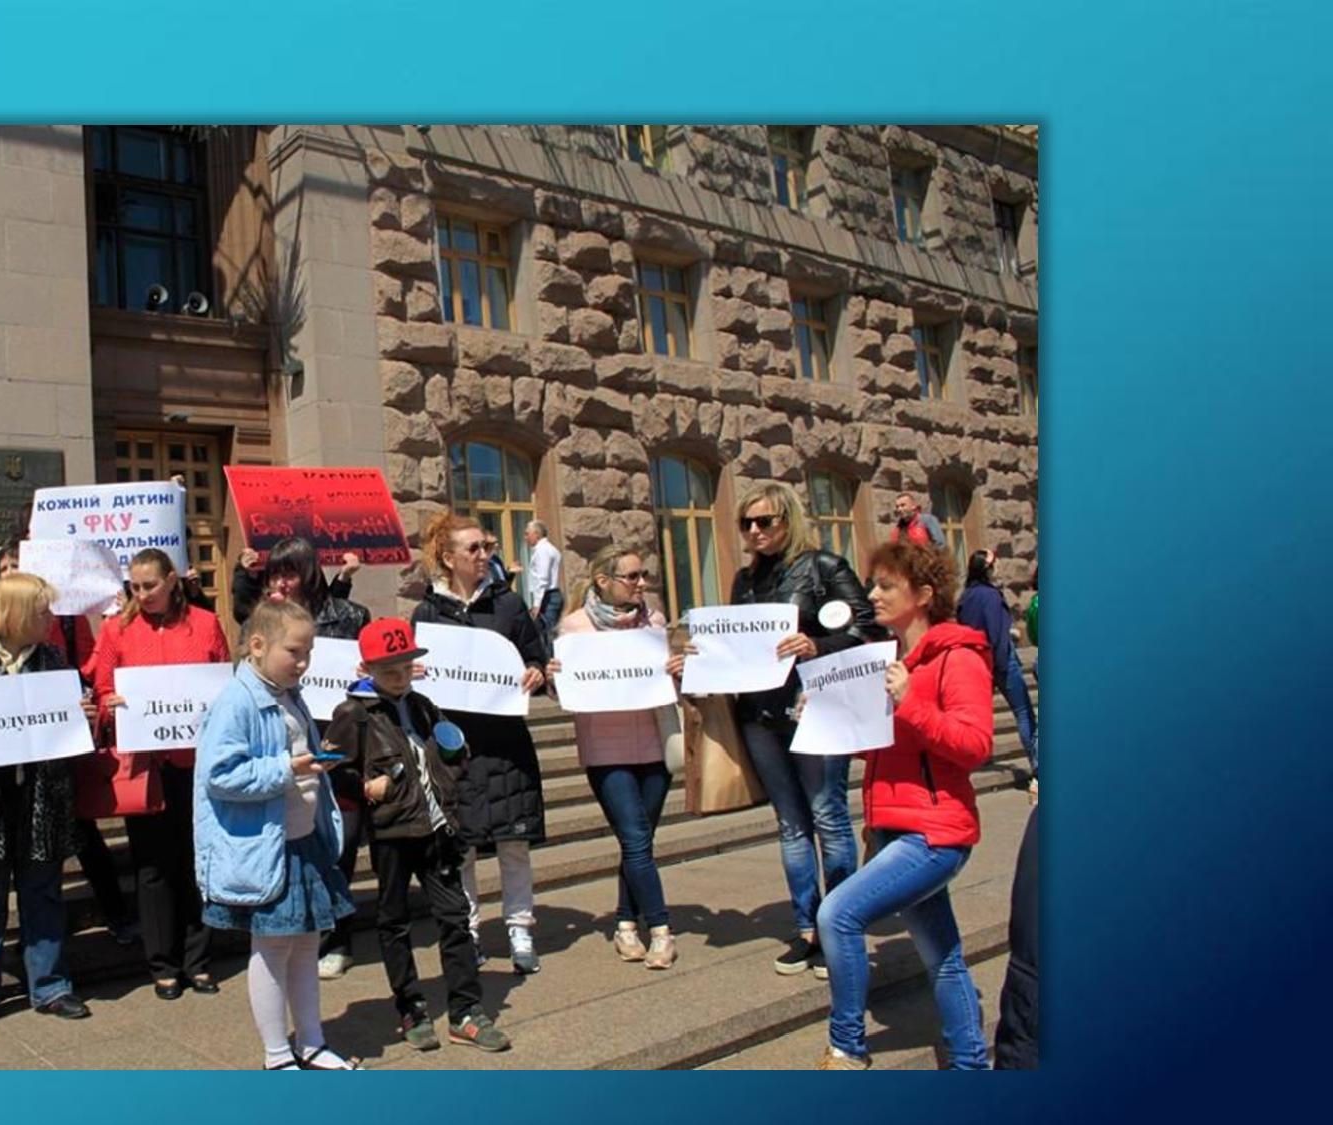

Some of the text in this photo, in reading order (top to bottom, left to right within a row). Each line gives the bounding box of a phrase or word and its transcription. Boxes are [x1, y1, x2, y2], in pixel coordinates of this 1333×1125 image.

[37, 493, 175, 512] КОЖНІЙ ДИТИНІ
[83, 511, 133, 534] ФКУ
[689, 616, 791, 638] російського
[383, 628, 410, 653] 23
[573, 665, 654, 682] можливо
[143, 699, 194, 717] Дітей
